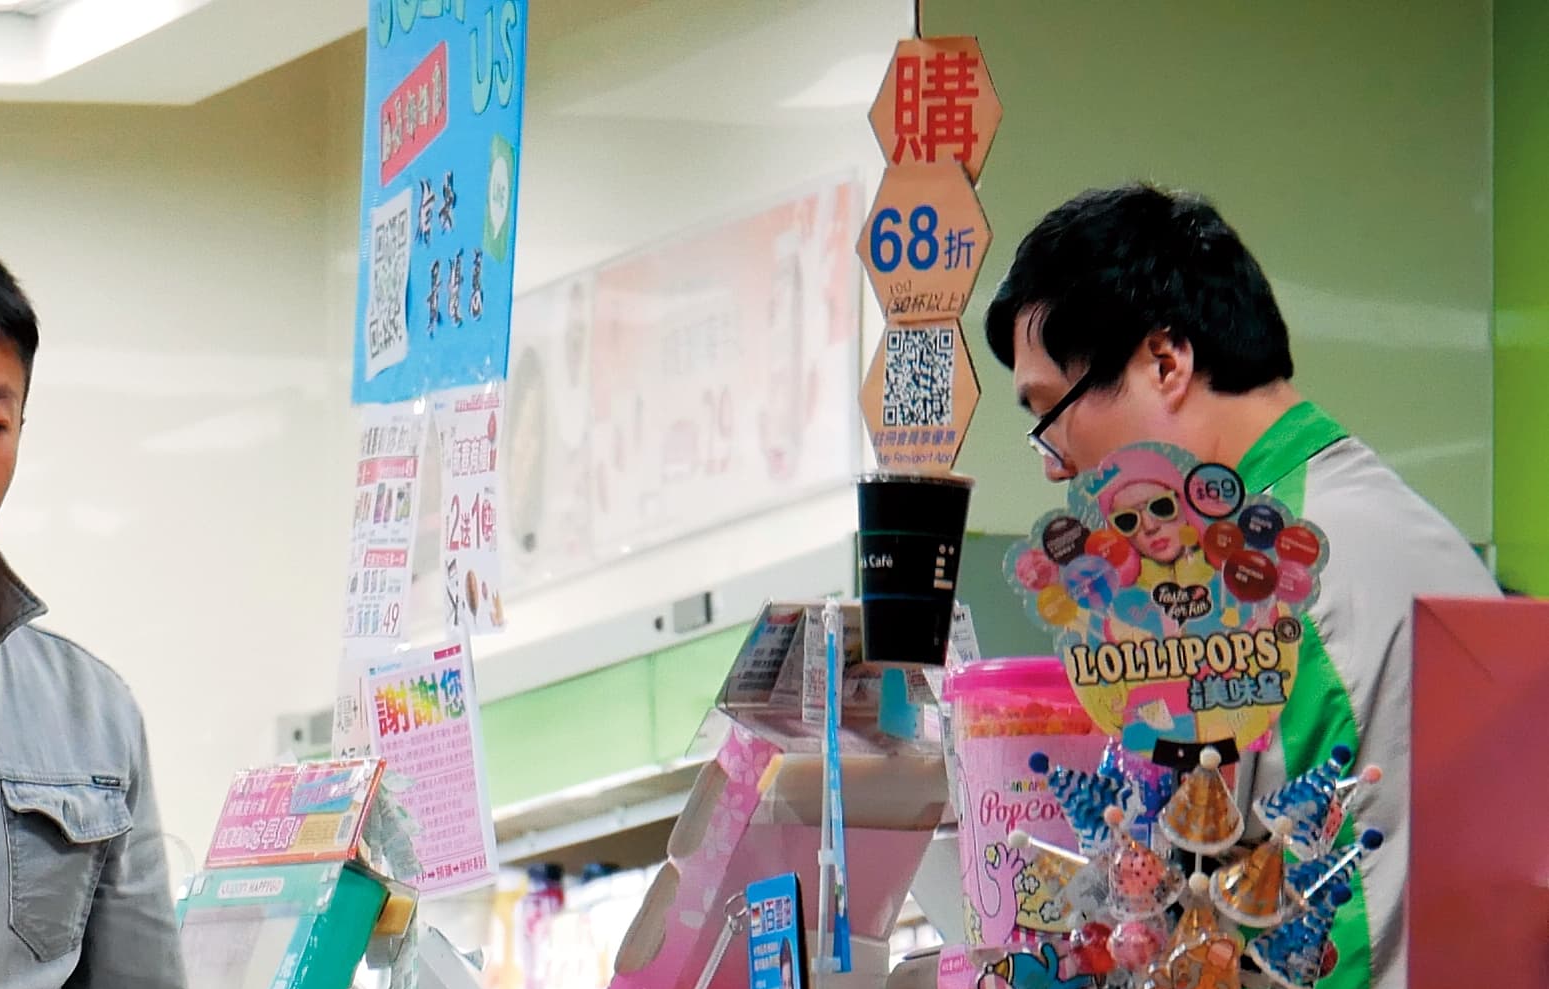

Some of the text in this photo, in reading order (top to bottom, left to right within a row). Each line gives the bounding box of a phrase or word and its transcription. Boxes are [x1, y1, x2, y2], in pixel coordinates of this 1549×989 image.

[470, 0, 517, 115] US
[892, 52, 979, 165] 購
[870, 205, 975, 273] 68折
[1073, 629, 1280, 686] LOLLIPOPS
[375, 668, 466, 738] 謝謝您
